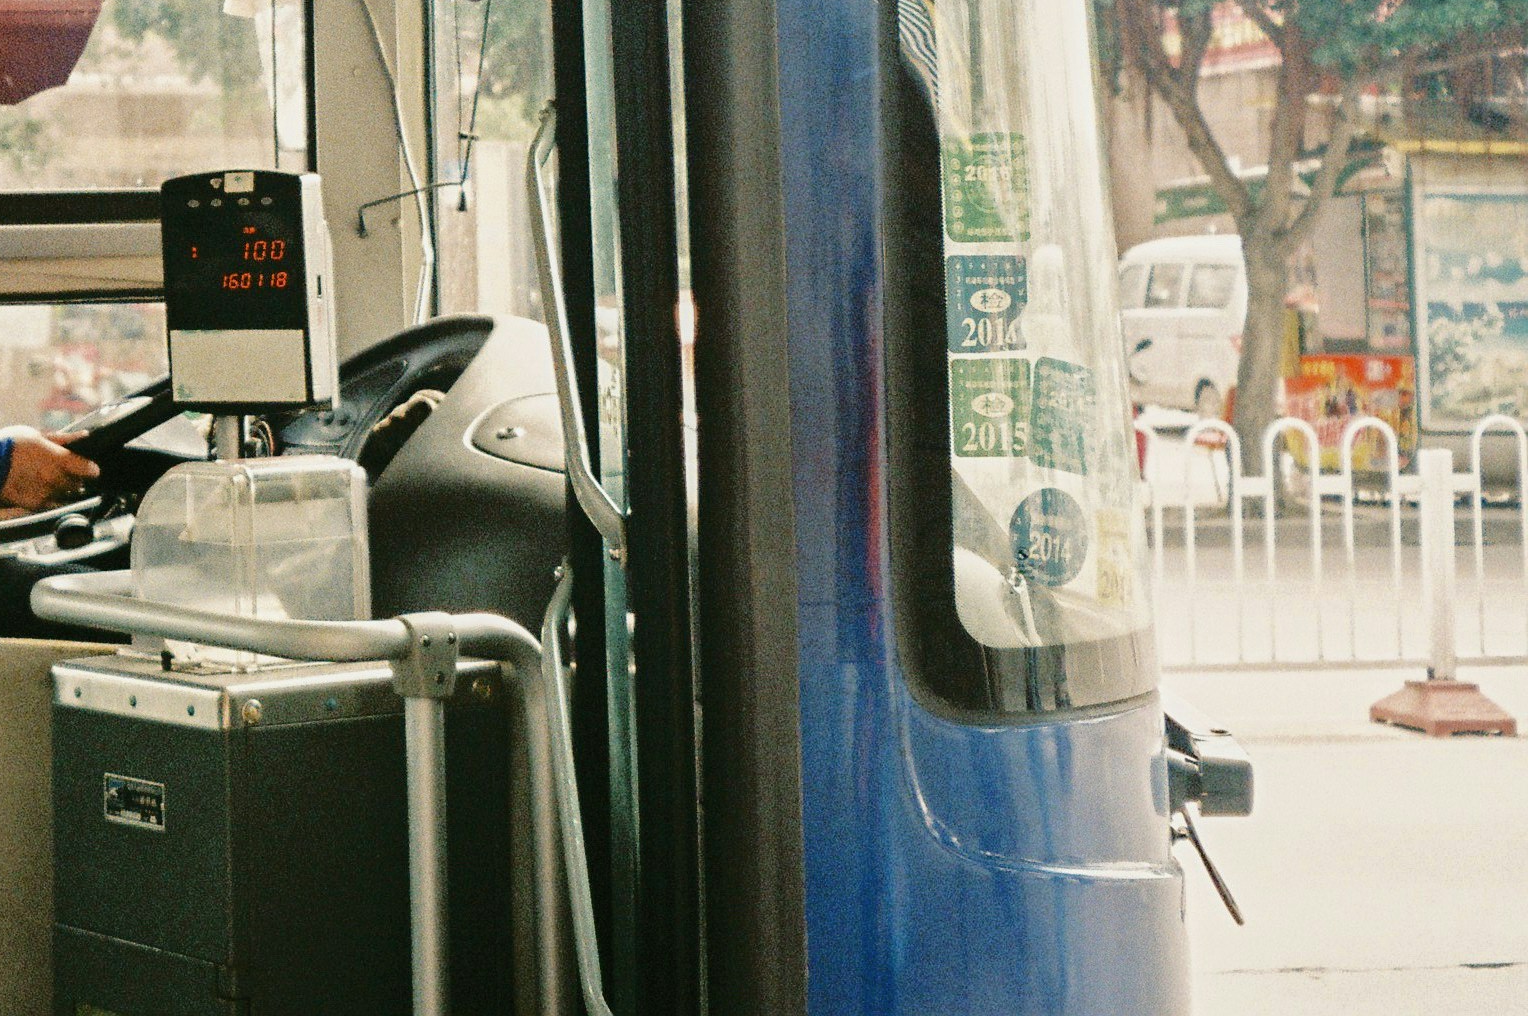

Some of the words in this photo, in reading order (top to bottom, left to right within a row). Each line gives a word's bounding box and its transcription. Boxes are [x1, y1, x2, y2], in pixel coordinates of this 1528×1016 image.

[243, 240, 286, 261] 100
[222, 271, 288, 290] 160118
[962, 422, 1028, 451] 2015
[1029, 531, 1072, 564] 2014
